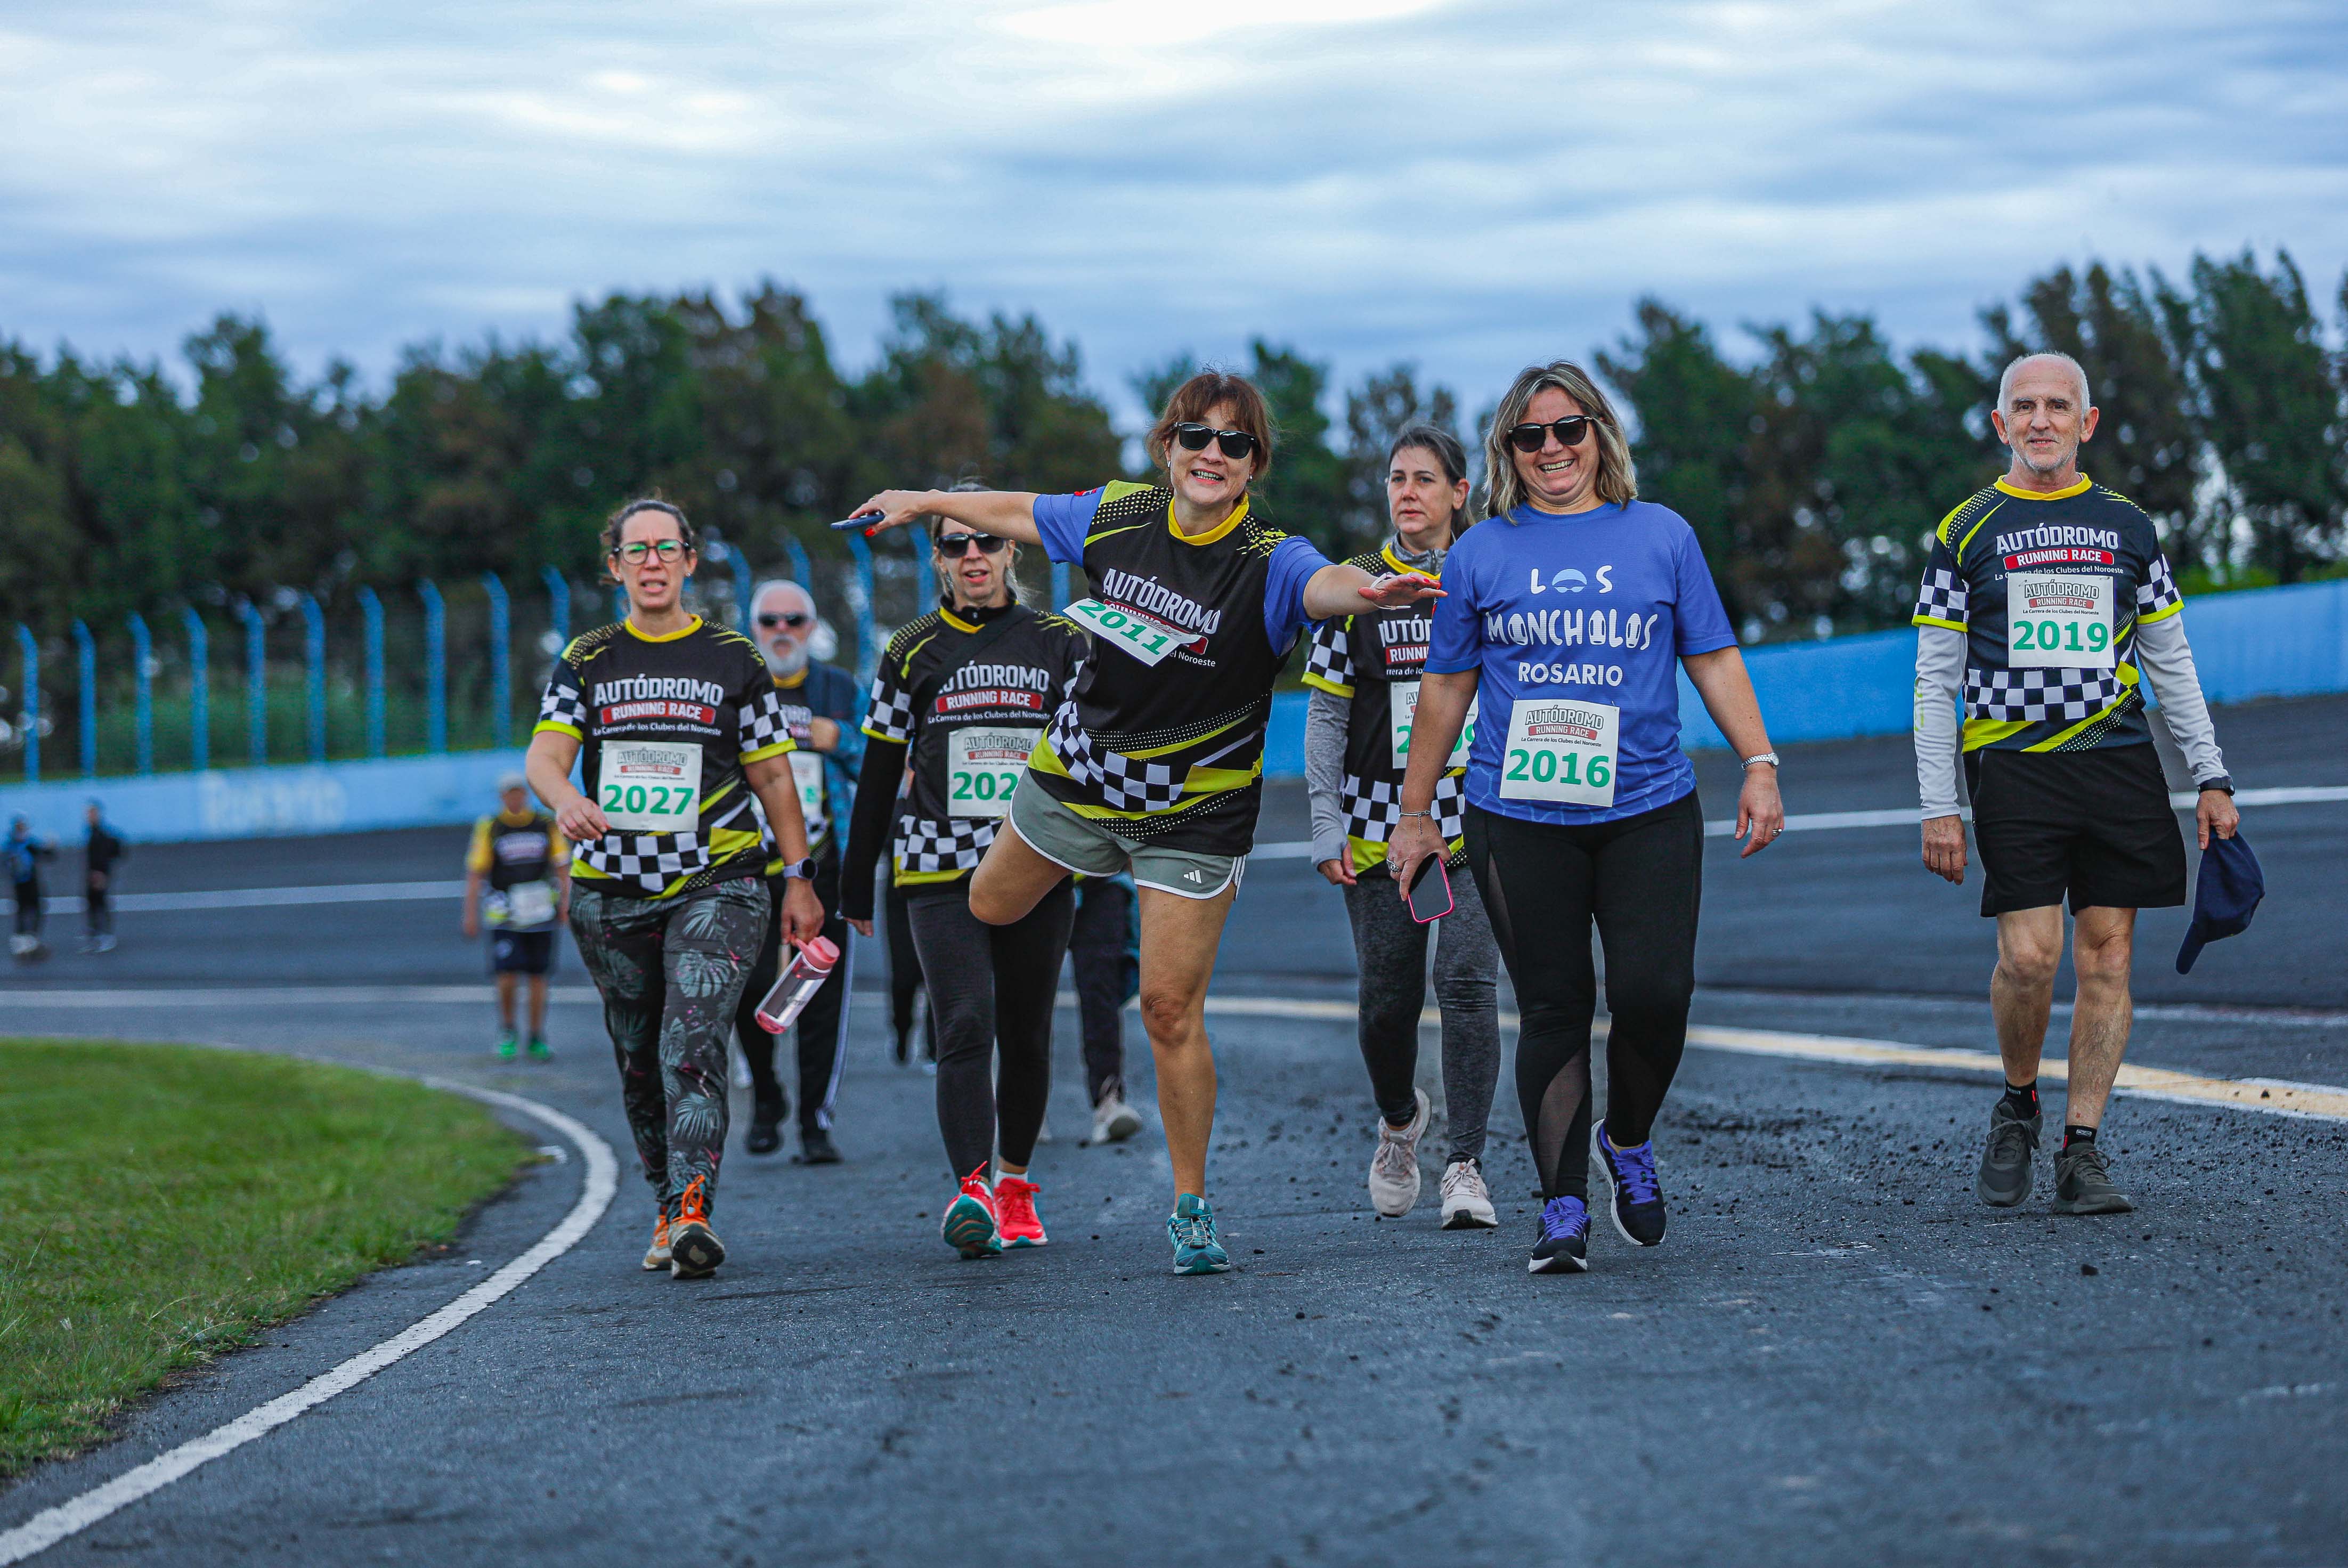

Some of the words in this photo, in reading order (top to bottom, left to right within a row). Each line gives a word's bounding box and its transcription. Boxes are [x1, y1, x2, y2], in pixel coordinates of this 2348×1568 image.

[1996, 523, 2119, 555] AUTÓDROMO
[2017, 549, 2068, 565] RUNNING
[2071, 549, 2101, 562] RACE
[2094, 565, 2124, 574] Noroeste
[1103, 568, 1221, 634] AUTÓDROMO
[2024, 579, 2099, 599] AUTÓDROMO
[2036, 597, 2067, 606] RUNNING
[2069, 598, 2087, 607] RACE
[1077, 600, 1169, 655] 2011
[1485, 608, 1658, 650] MONCHOLOS
[2013, 621, 2108, 653] 2019
[1179, 651, 1216, 667] Noroeste
[1404, 667, 1415, 676] de
[938, 660, 1050, 694] UTÓDROMO
[1518, 662, 1623, 687] ROSARIO
[594, 673, 724, 707] AUTÓDROMO
[946, 690, 997, 710] RUNNING
[1001, 690, 1031, 706] RACE
[611, 702, 666, 721] RUNNING
[669, 702, 703, 720] RACE
[984, 711, 1008, 719] Clubes
[1525, 705, 1604, 730] AUTÓDROMO
[1536, 725, 1568, 734] RUNNING
[1571, 726, 1590, 737] RACE
[1506, 749, 1610, 788] 2016
[953, 771, 1019, 801] 202
[603, 785, 694, 814] 2027
